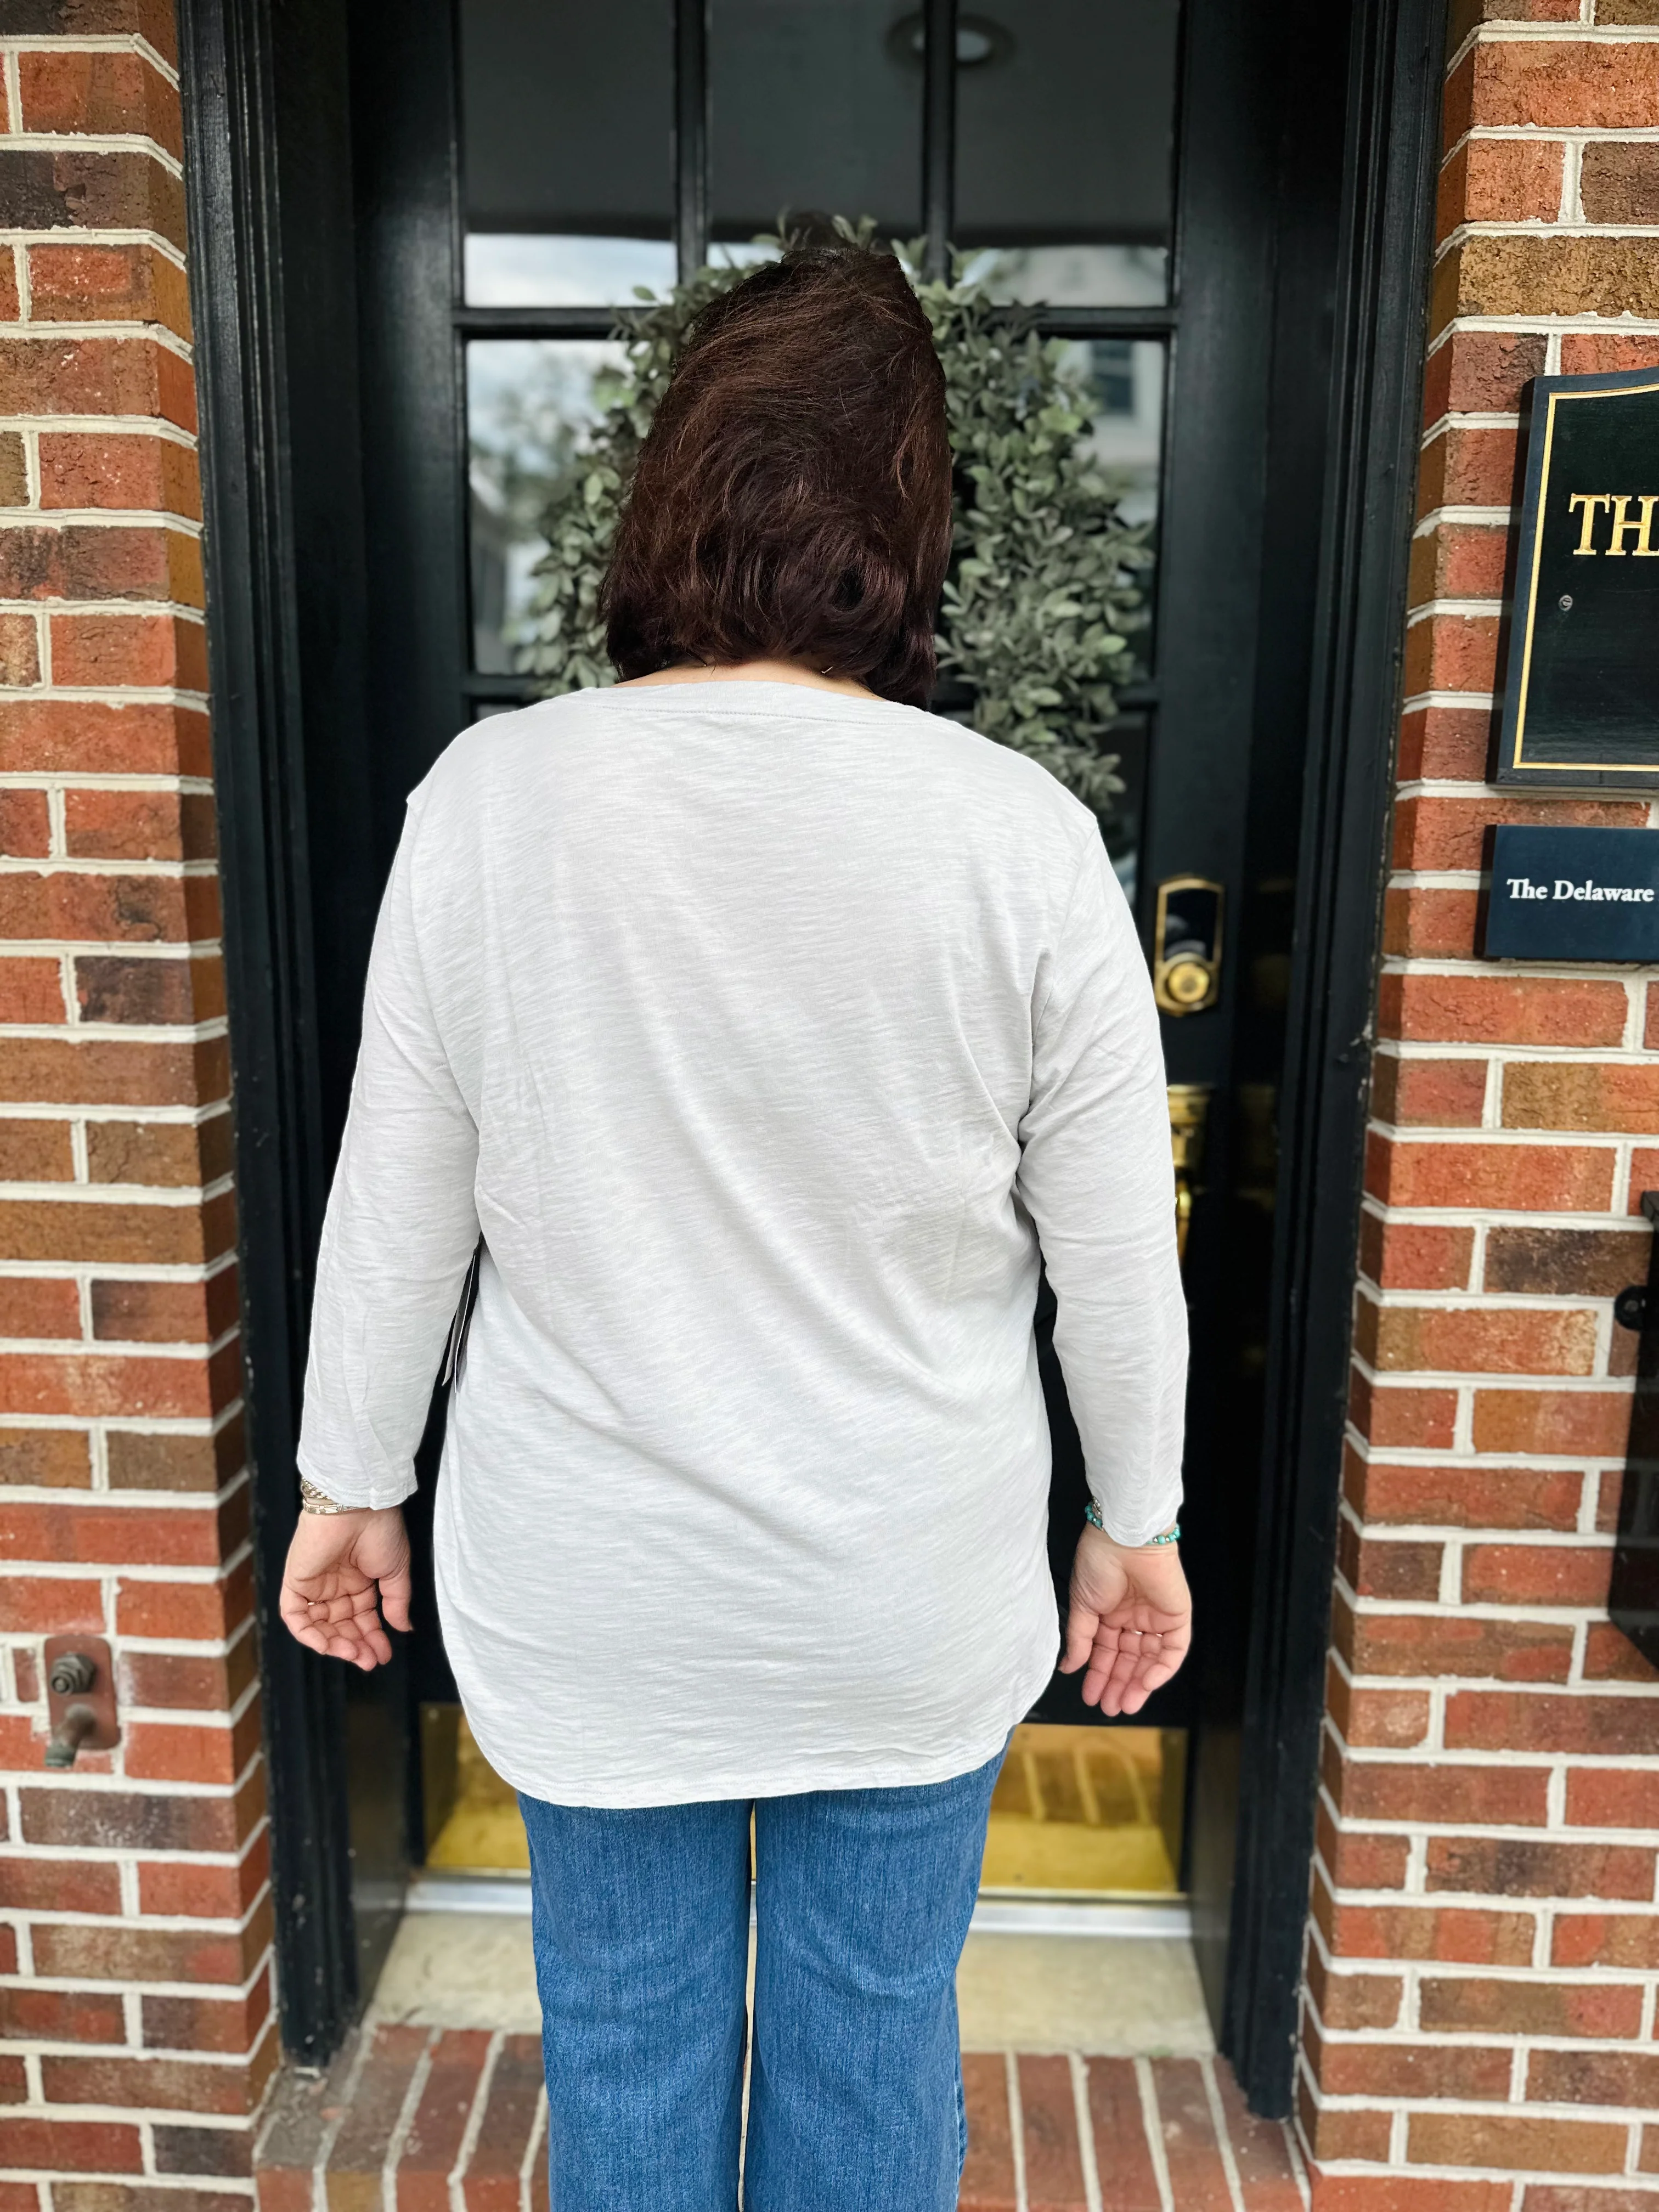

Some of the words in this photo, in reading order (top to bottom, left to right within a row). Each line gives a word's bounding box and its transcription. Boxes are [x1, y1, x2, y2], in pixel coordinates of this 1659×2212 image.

[1568, 493, 1659, 556] TH
[1506, 878, 1549, 899] The
[1551, 879, 1655, 902] Delaware
